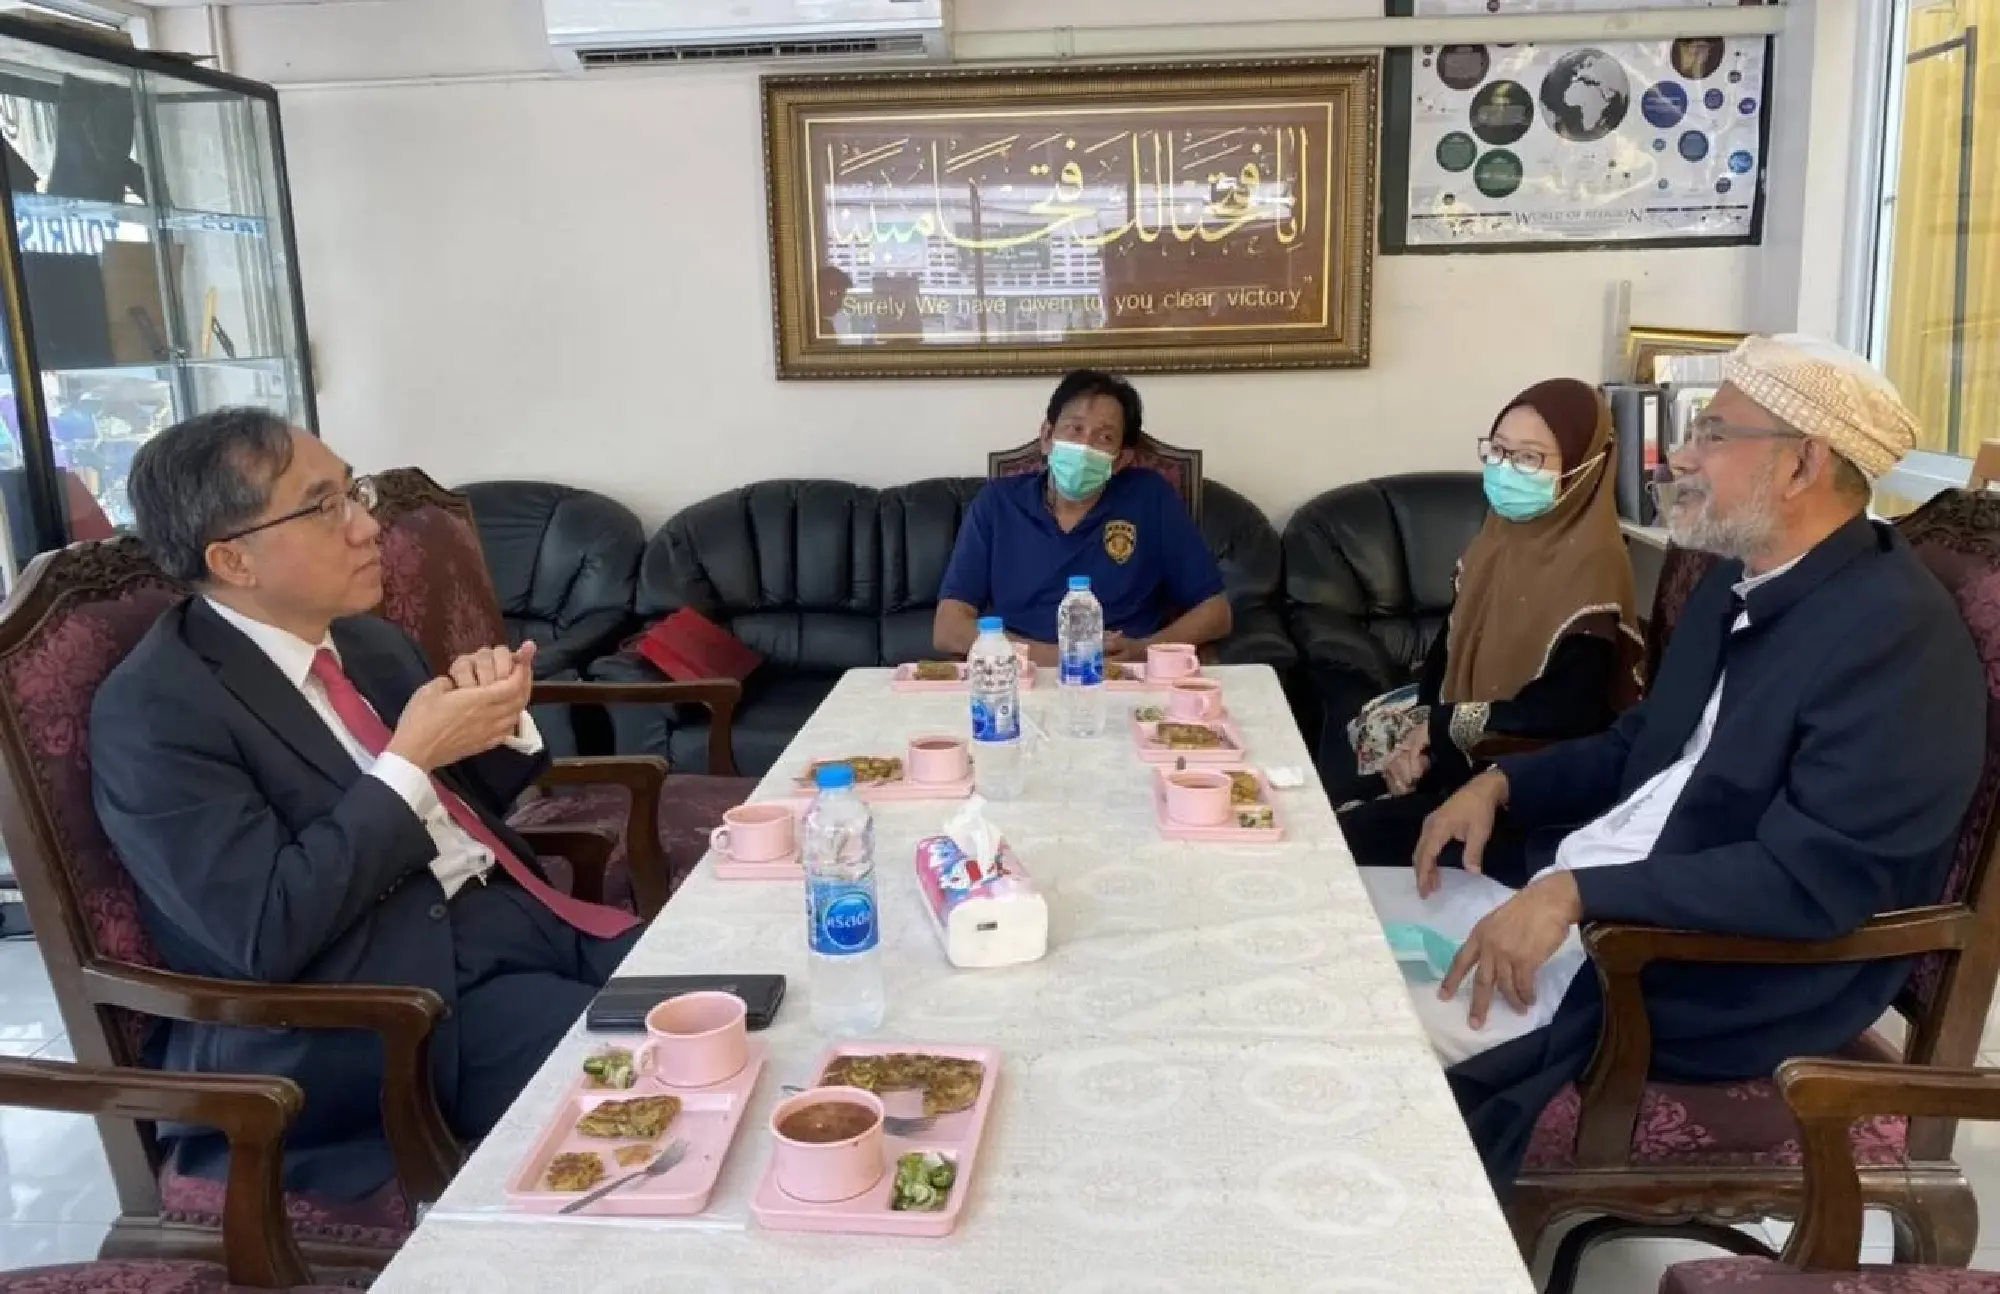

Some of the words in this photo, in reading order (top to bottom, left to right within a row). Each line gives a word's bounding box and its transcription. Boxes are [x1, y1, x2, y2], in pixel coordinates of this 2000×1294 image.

[915, 295, 950, 315] We
[957, 292, 1007, 316] have
[1019, 293, 1074, 318] given
[1084, 292, 1102, 312] to
[1113, 292, 1153, 316] you
[1162, 287, 1215, 309] clear
